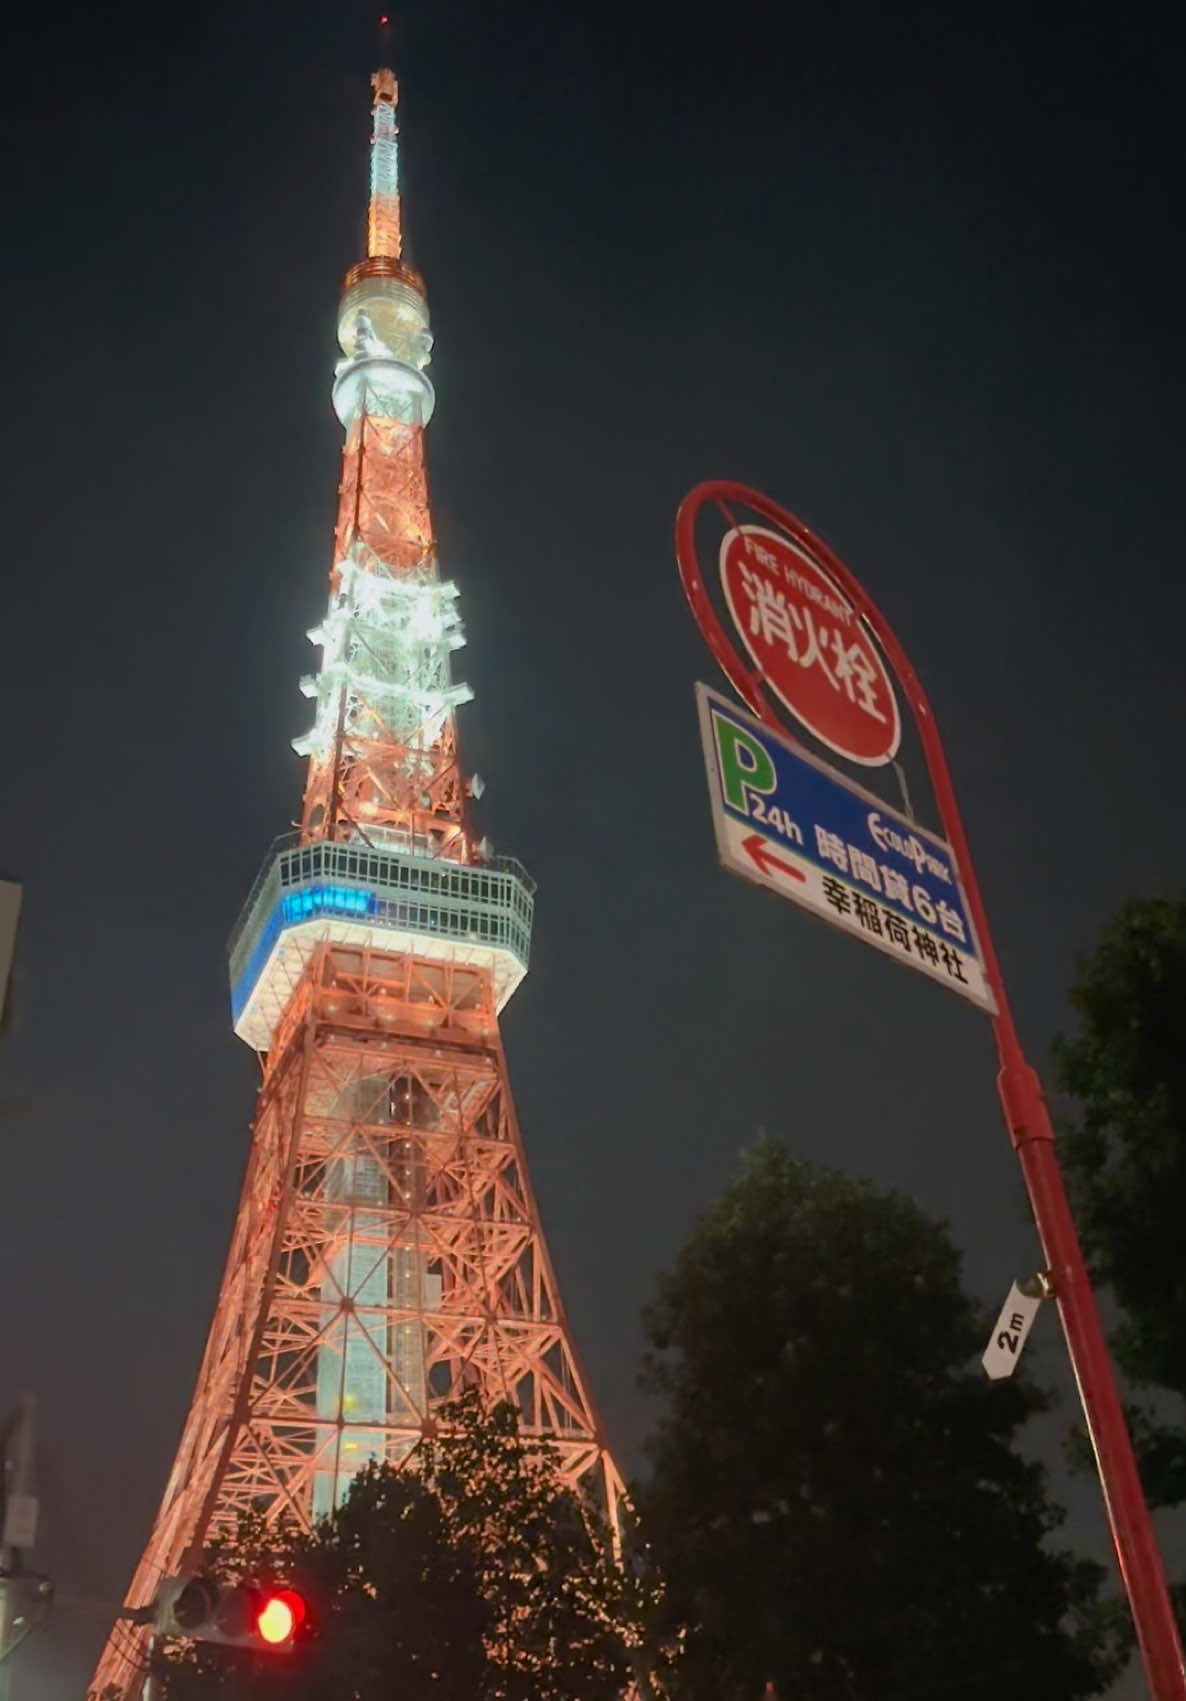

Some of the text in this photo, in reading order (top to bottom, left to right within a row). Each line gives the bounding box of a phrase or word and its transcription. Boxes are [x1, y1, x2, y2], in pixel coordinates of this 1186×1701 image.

[743, 536, 779, 576] FIRE
[738, 560, 888, 724] 消火栓
[711, 708, 778, 816] P
[749, 792, 805, 845] 24h
[822, 875, 968, 984] 幸稲荷神社
[997, 1313, 1025, 1354] 2m
